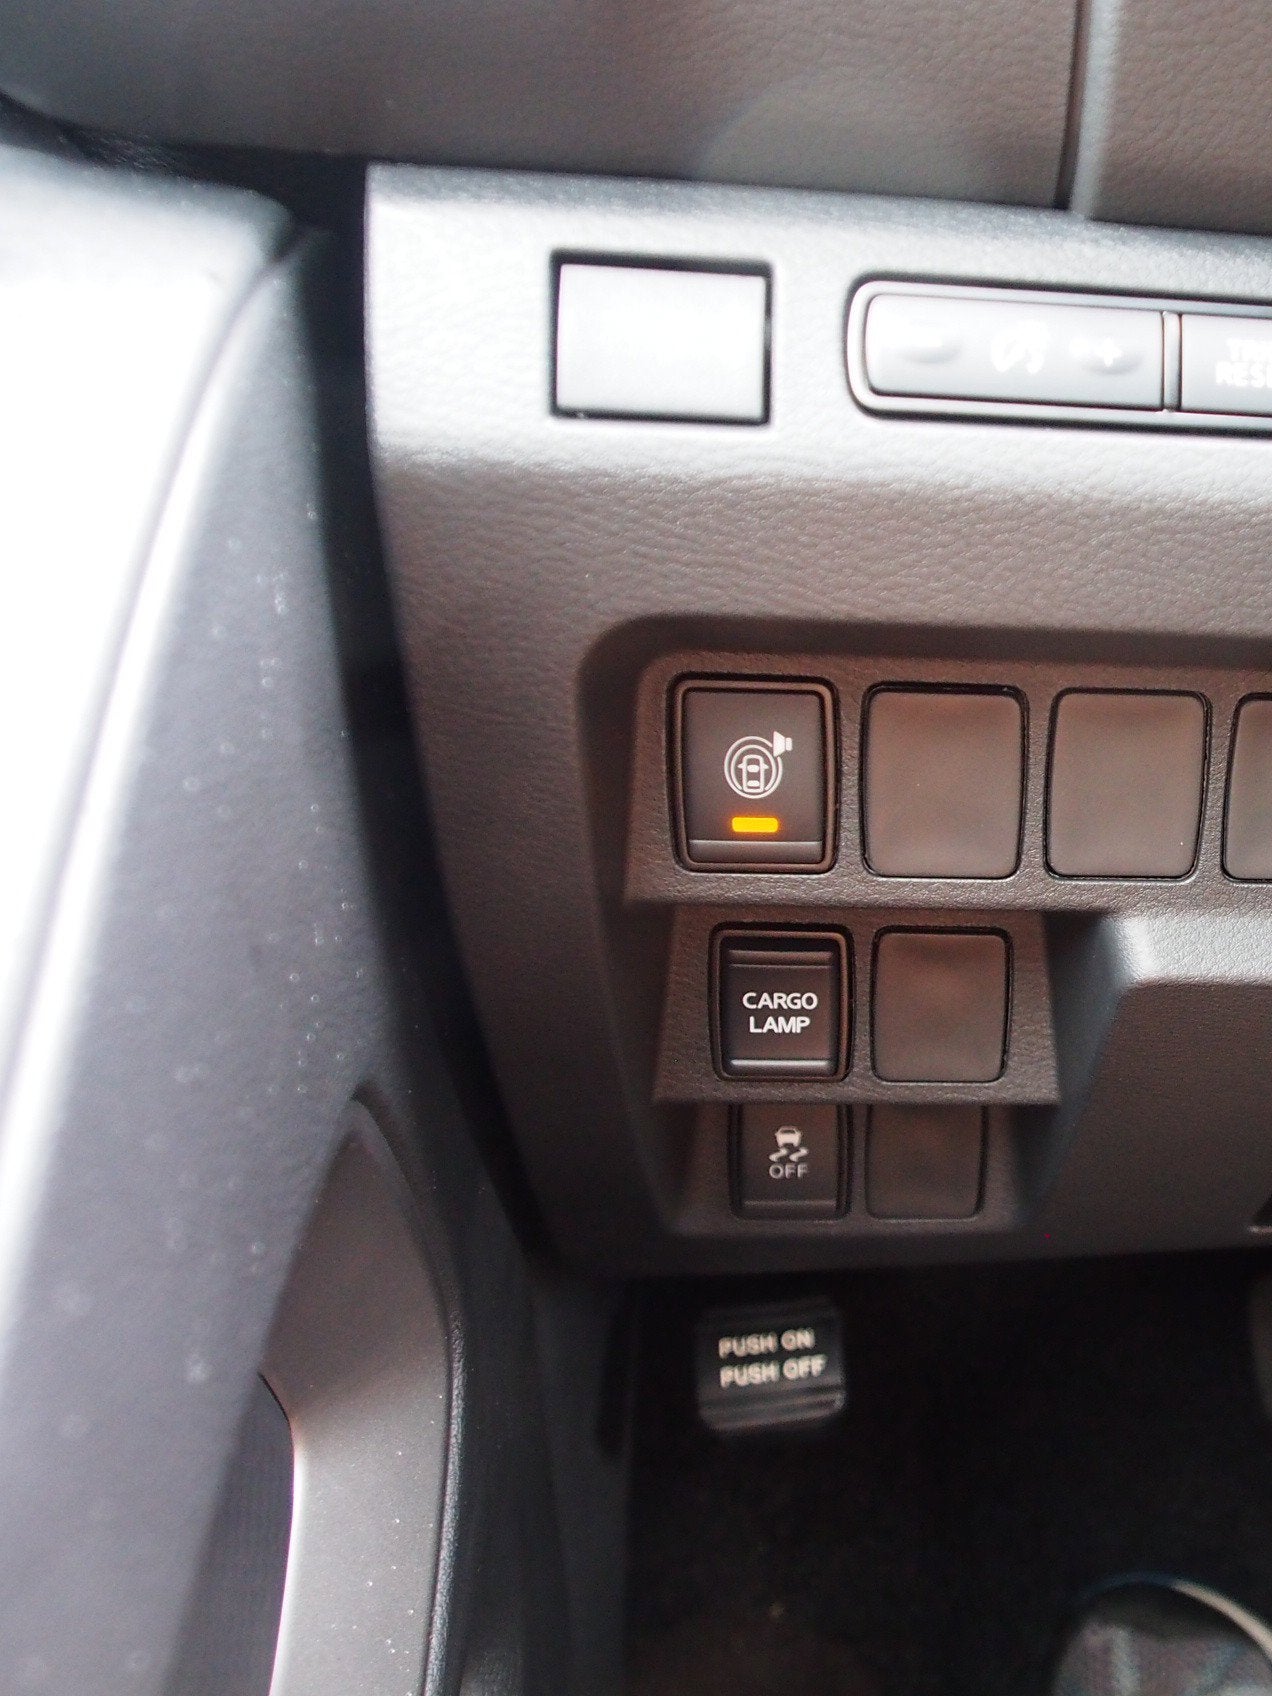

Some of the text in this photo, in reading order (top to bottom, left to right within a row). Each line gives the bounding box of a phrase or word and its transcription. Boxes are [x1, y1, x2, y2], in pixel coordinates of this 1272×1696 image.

[742, 992, 818, 1010] CARGO
[749, 1016, 811, 1034] LAMP
[769, 1163, 808, 1179] OFF
[718, 1327, 815, 1359] PUSH ON
[720, 1354, 827, 1388] PUSH OFF
